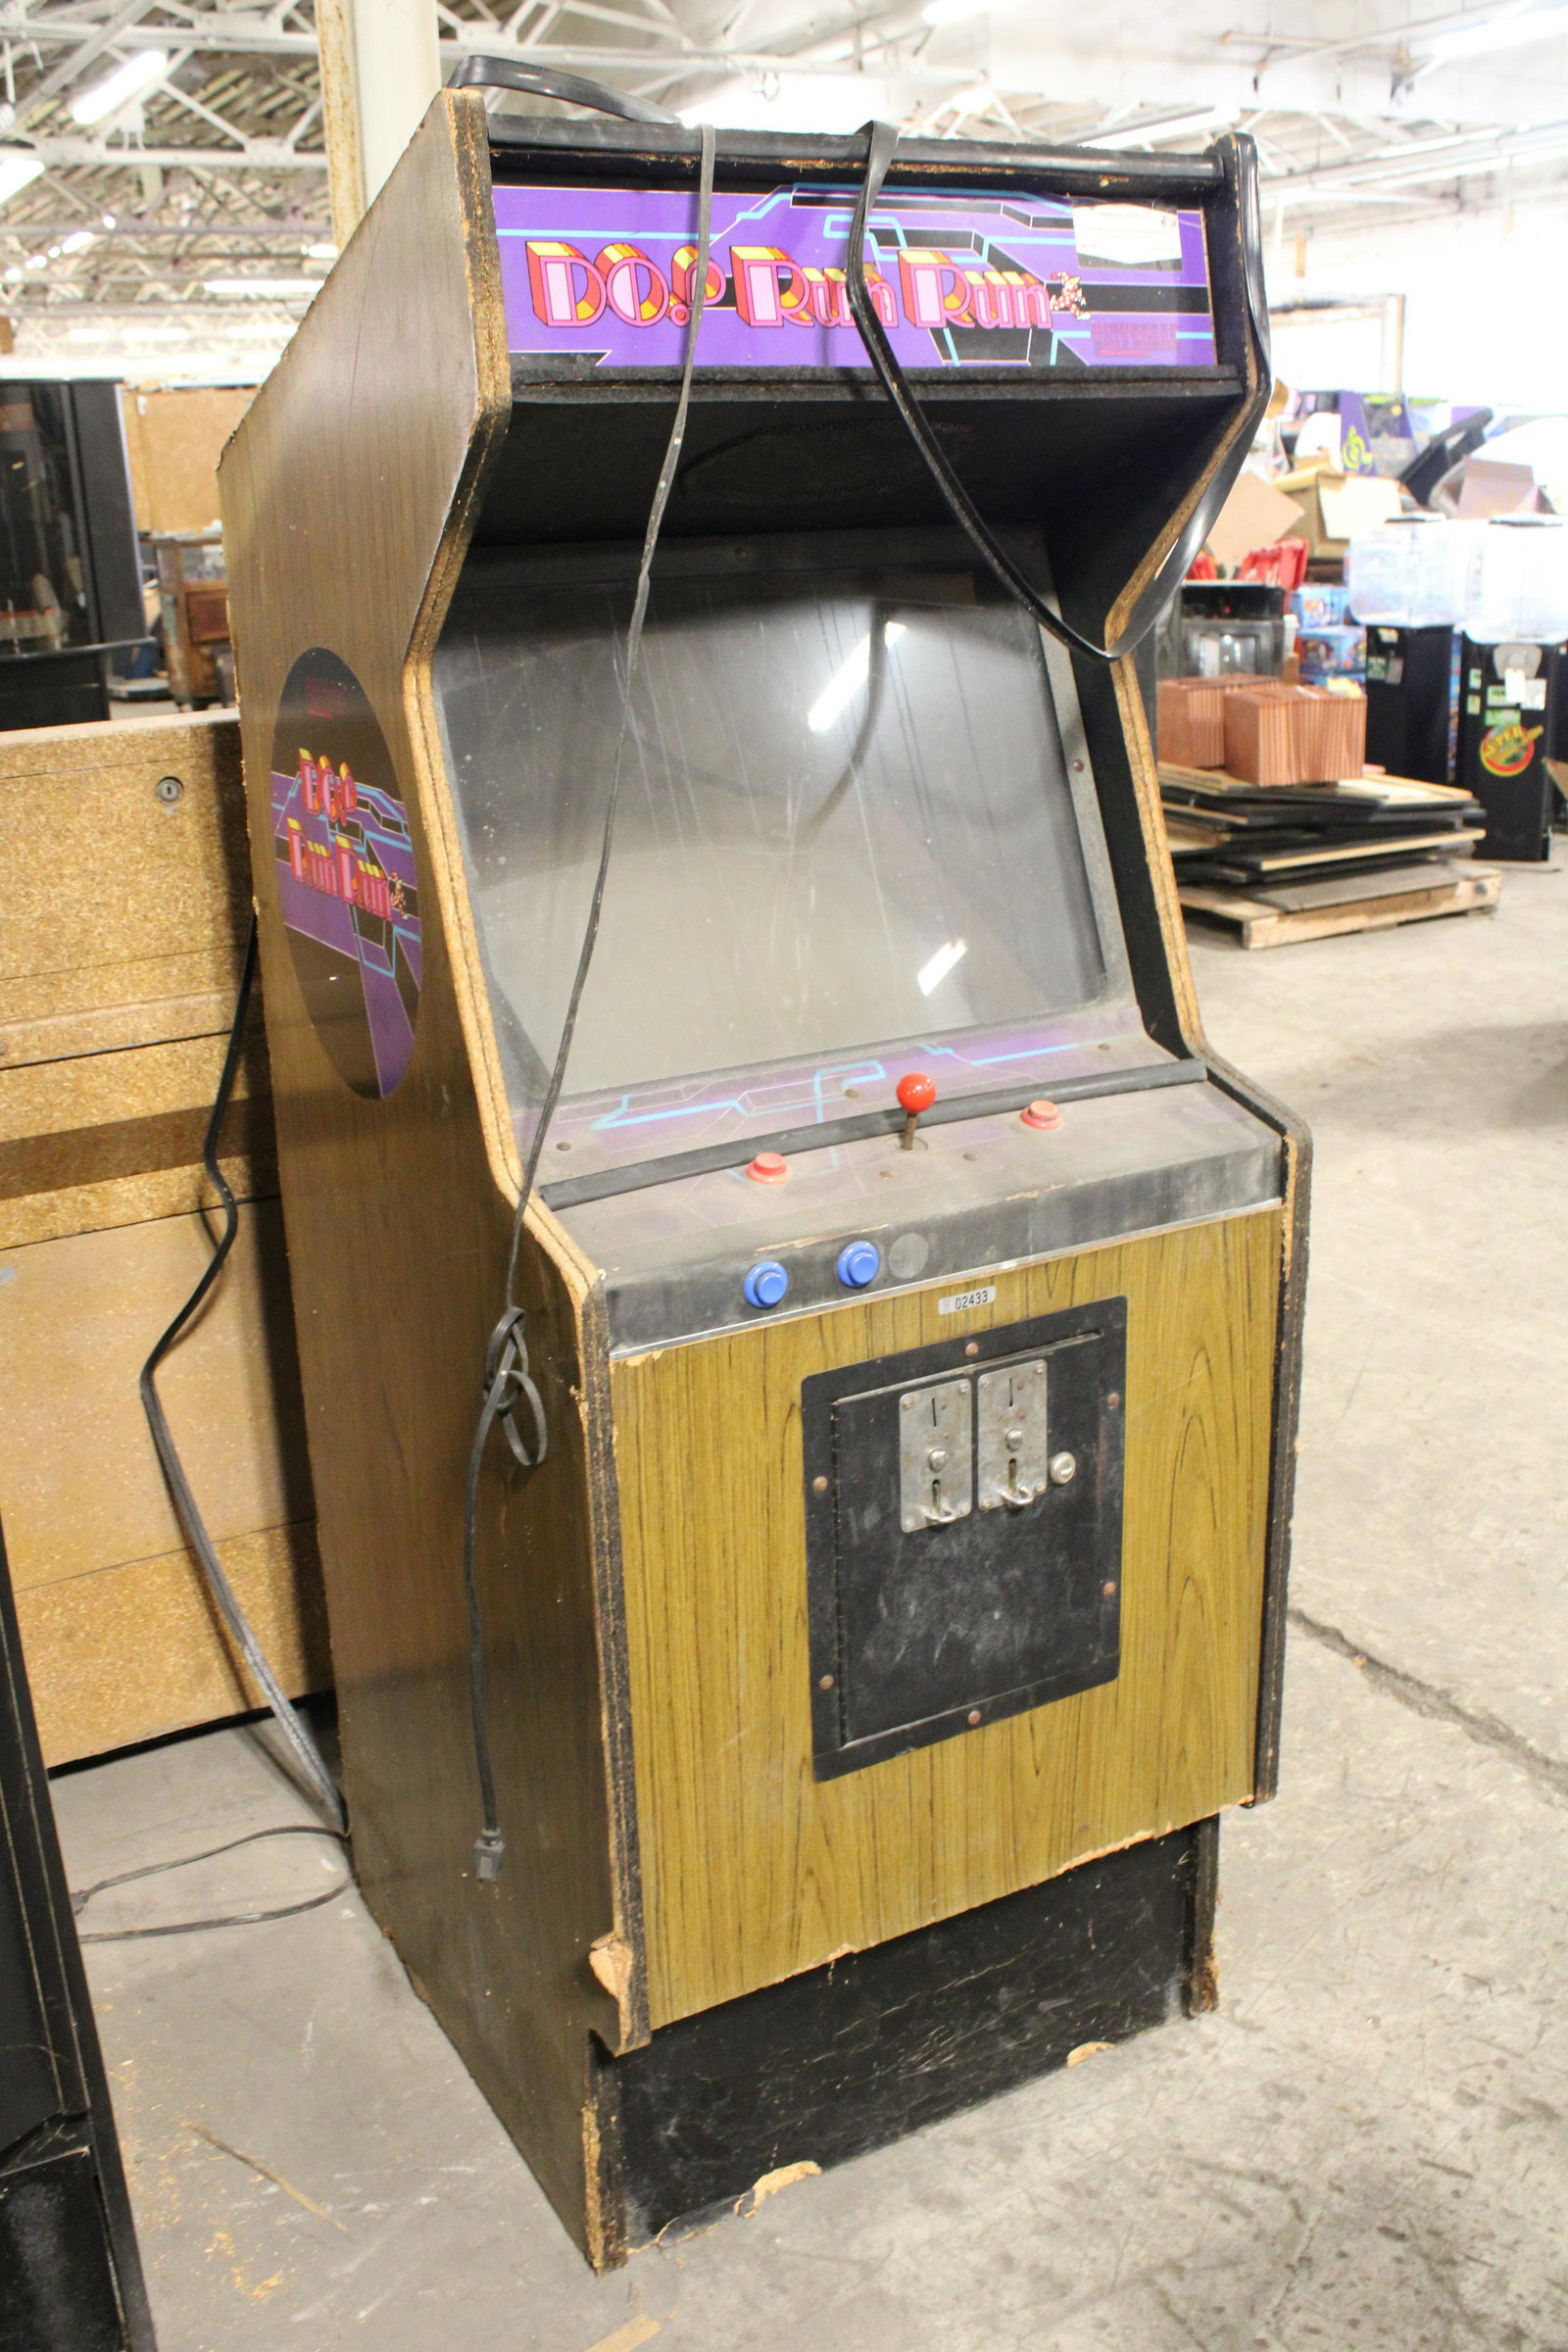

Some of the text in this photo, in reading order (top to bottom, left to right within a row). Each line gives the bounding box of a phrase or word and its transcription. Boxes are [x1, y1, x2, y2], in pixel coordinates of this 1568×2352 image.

[729, 246, 899, 328] Run
[897, 250, 1054, 329] Run
[335, 835, 392, 921] Run
[955, 1290, 988, 1310] 02433
